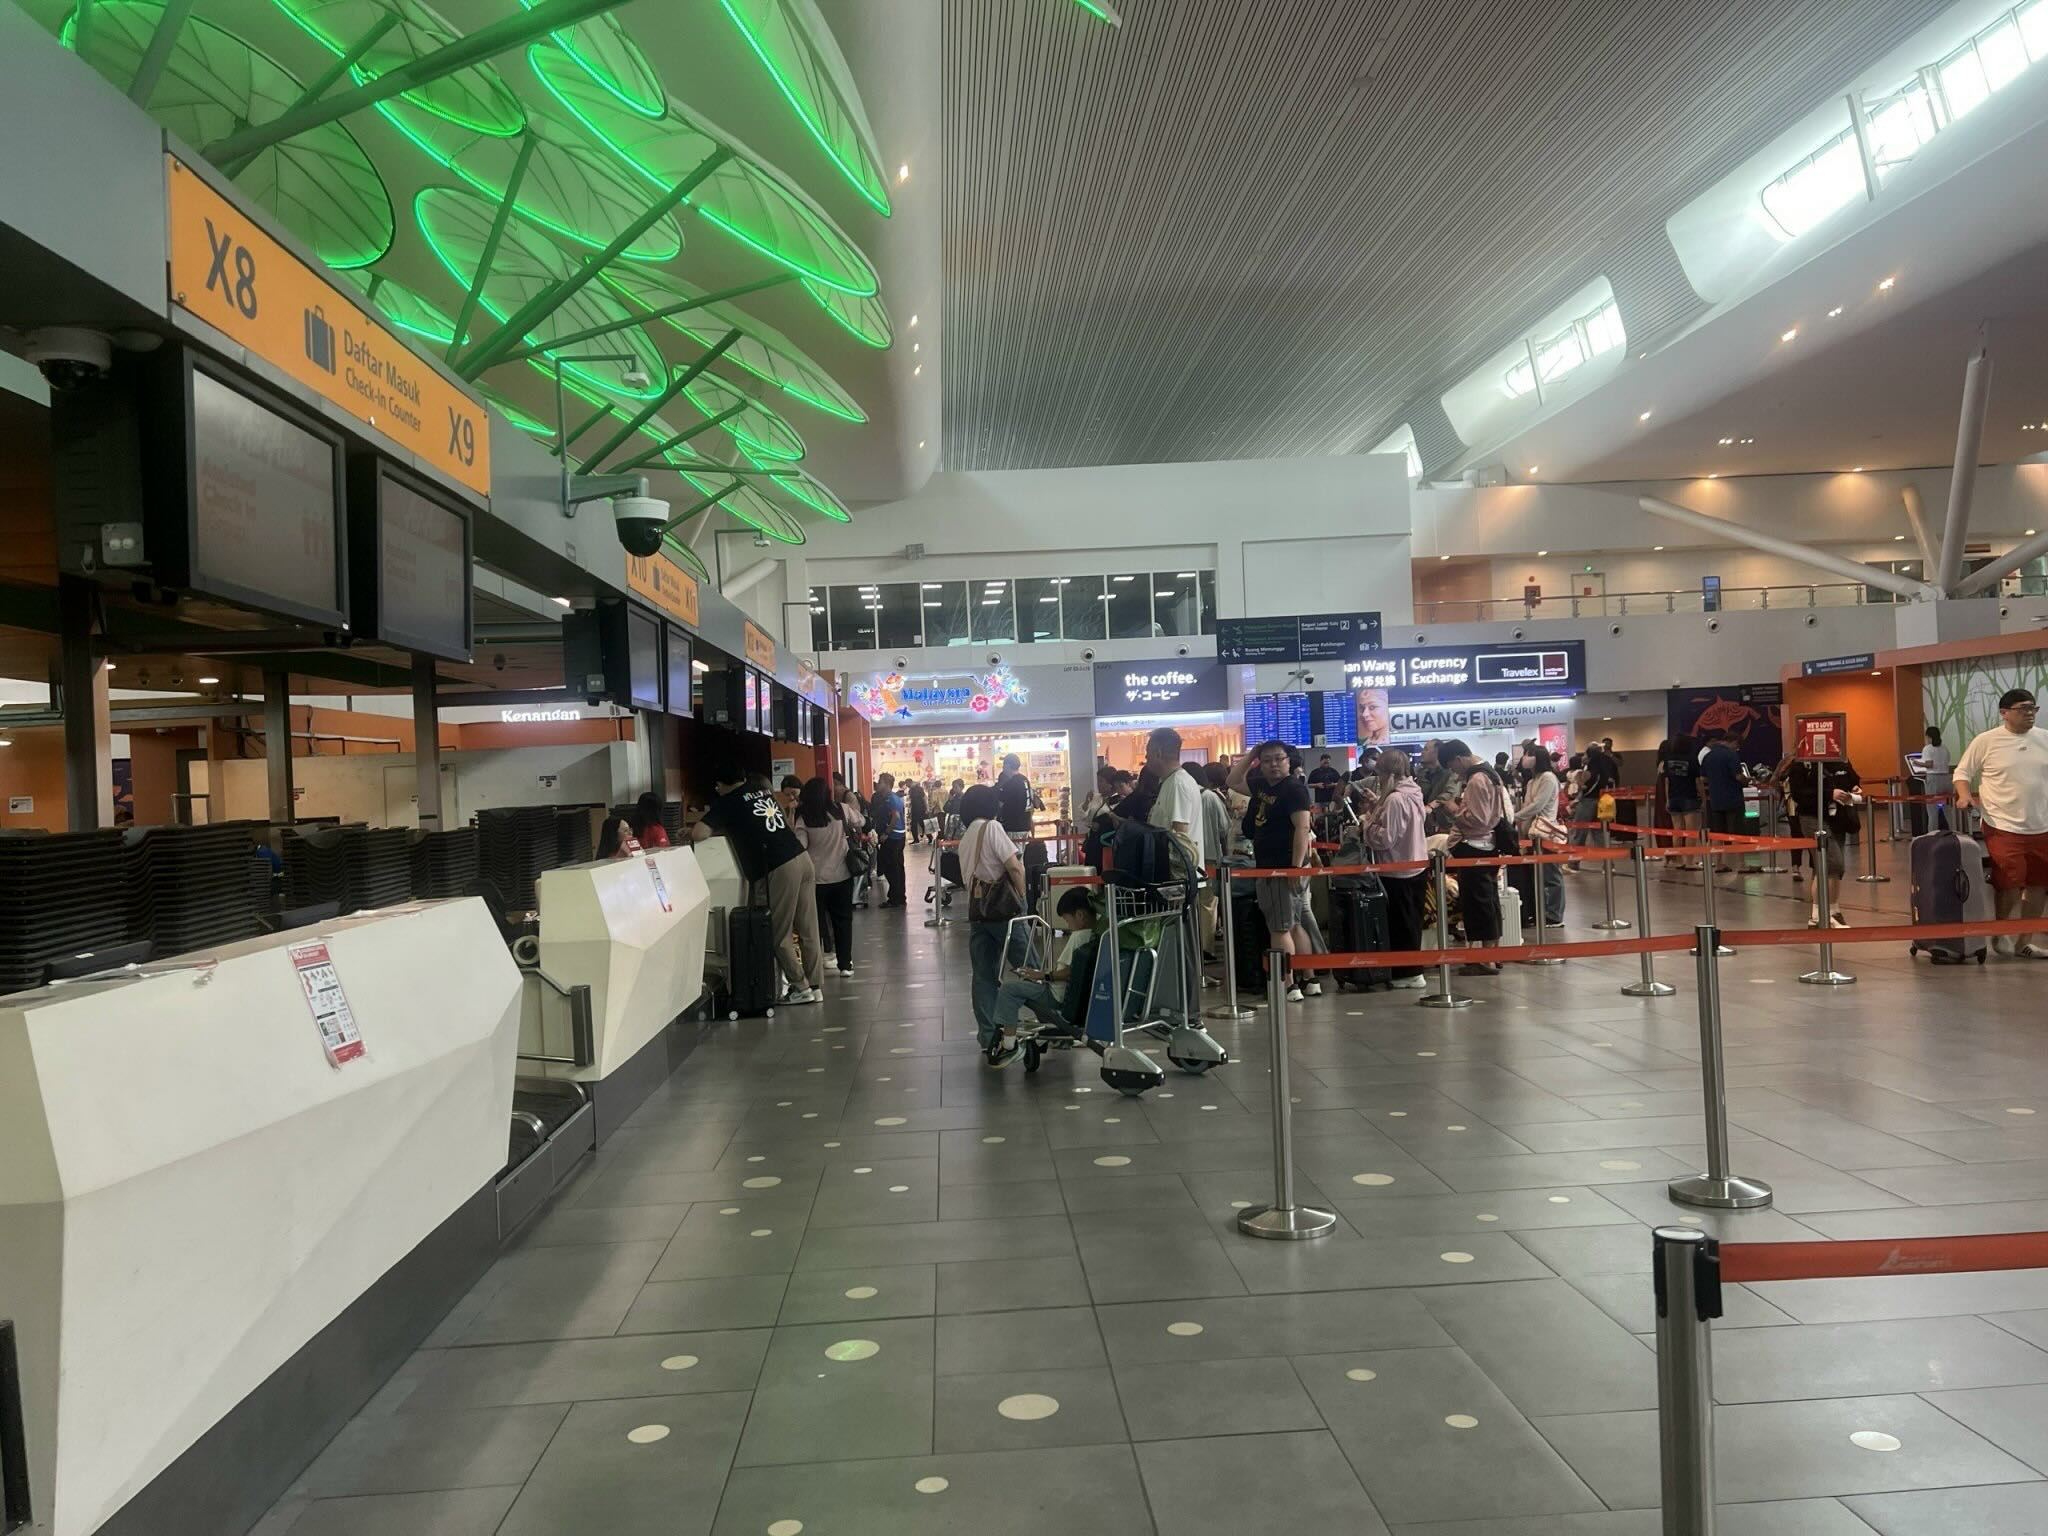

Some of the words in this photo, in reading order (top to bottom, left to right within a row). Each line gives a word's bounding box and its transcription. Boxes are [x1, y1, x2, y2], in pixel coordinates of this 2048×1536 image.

[205, 217, 258, 320] X8
[344, 329, 383, 377] Daftar
[386, 366, 421, 407] Masuk
[345, 367, 387, 411] Check-In
[388, 397, 422, 433] Counter
[448, 405, 475, 467] X9
[1362, 660, 1397, 673] Wang
[1411, 657, 1468, 670] Currency
[1124, 673, 1148, 687] the
[1151, 671, 1198, 686] coffee.
[1412, 672, 1468, 685] Exchange
[1501, 667, 1539, 678] Travelex
[902, 687, 971, 702] Malaysia
[945, 698, 967, 706] SHOP
[1488, 705, 1556, 716] PENGURUPAN
[1489, 717, 1519, 726] WANG
[1820, 721, 1833, 729] LOVE
